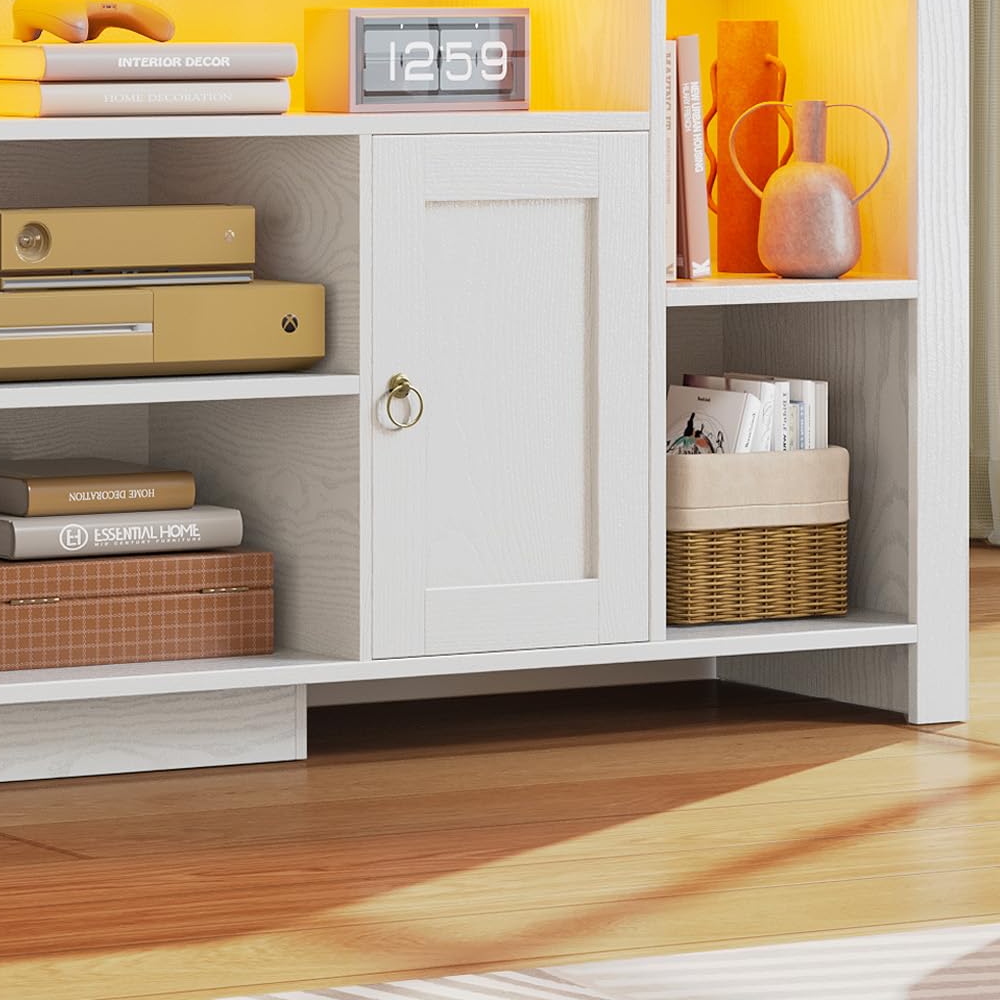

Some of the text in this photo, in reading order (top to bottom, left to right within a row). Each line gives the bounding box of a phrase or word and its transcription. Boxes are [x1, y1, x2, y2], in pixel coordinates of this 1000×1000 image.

[118, 56, 231, 68] INTERIOR DECOR
[104, 93, 232, 103] HOME DECORATION
[693, 133, 704, 173] HOUSING
[69, 488, 155, 501] HOME DECORATION
[94, 526, 158, 542] ESSENTIAL
[160, 524, 201, 539] HOME
